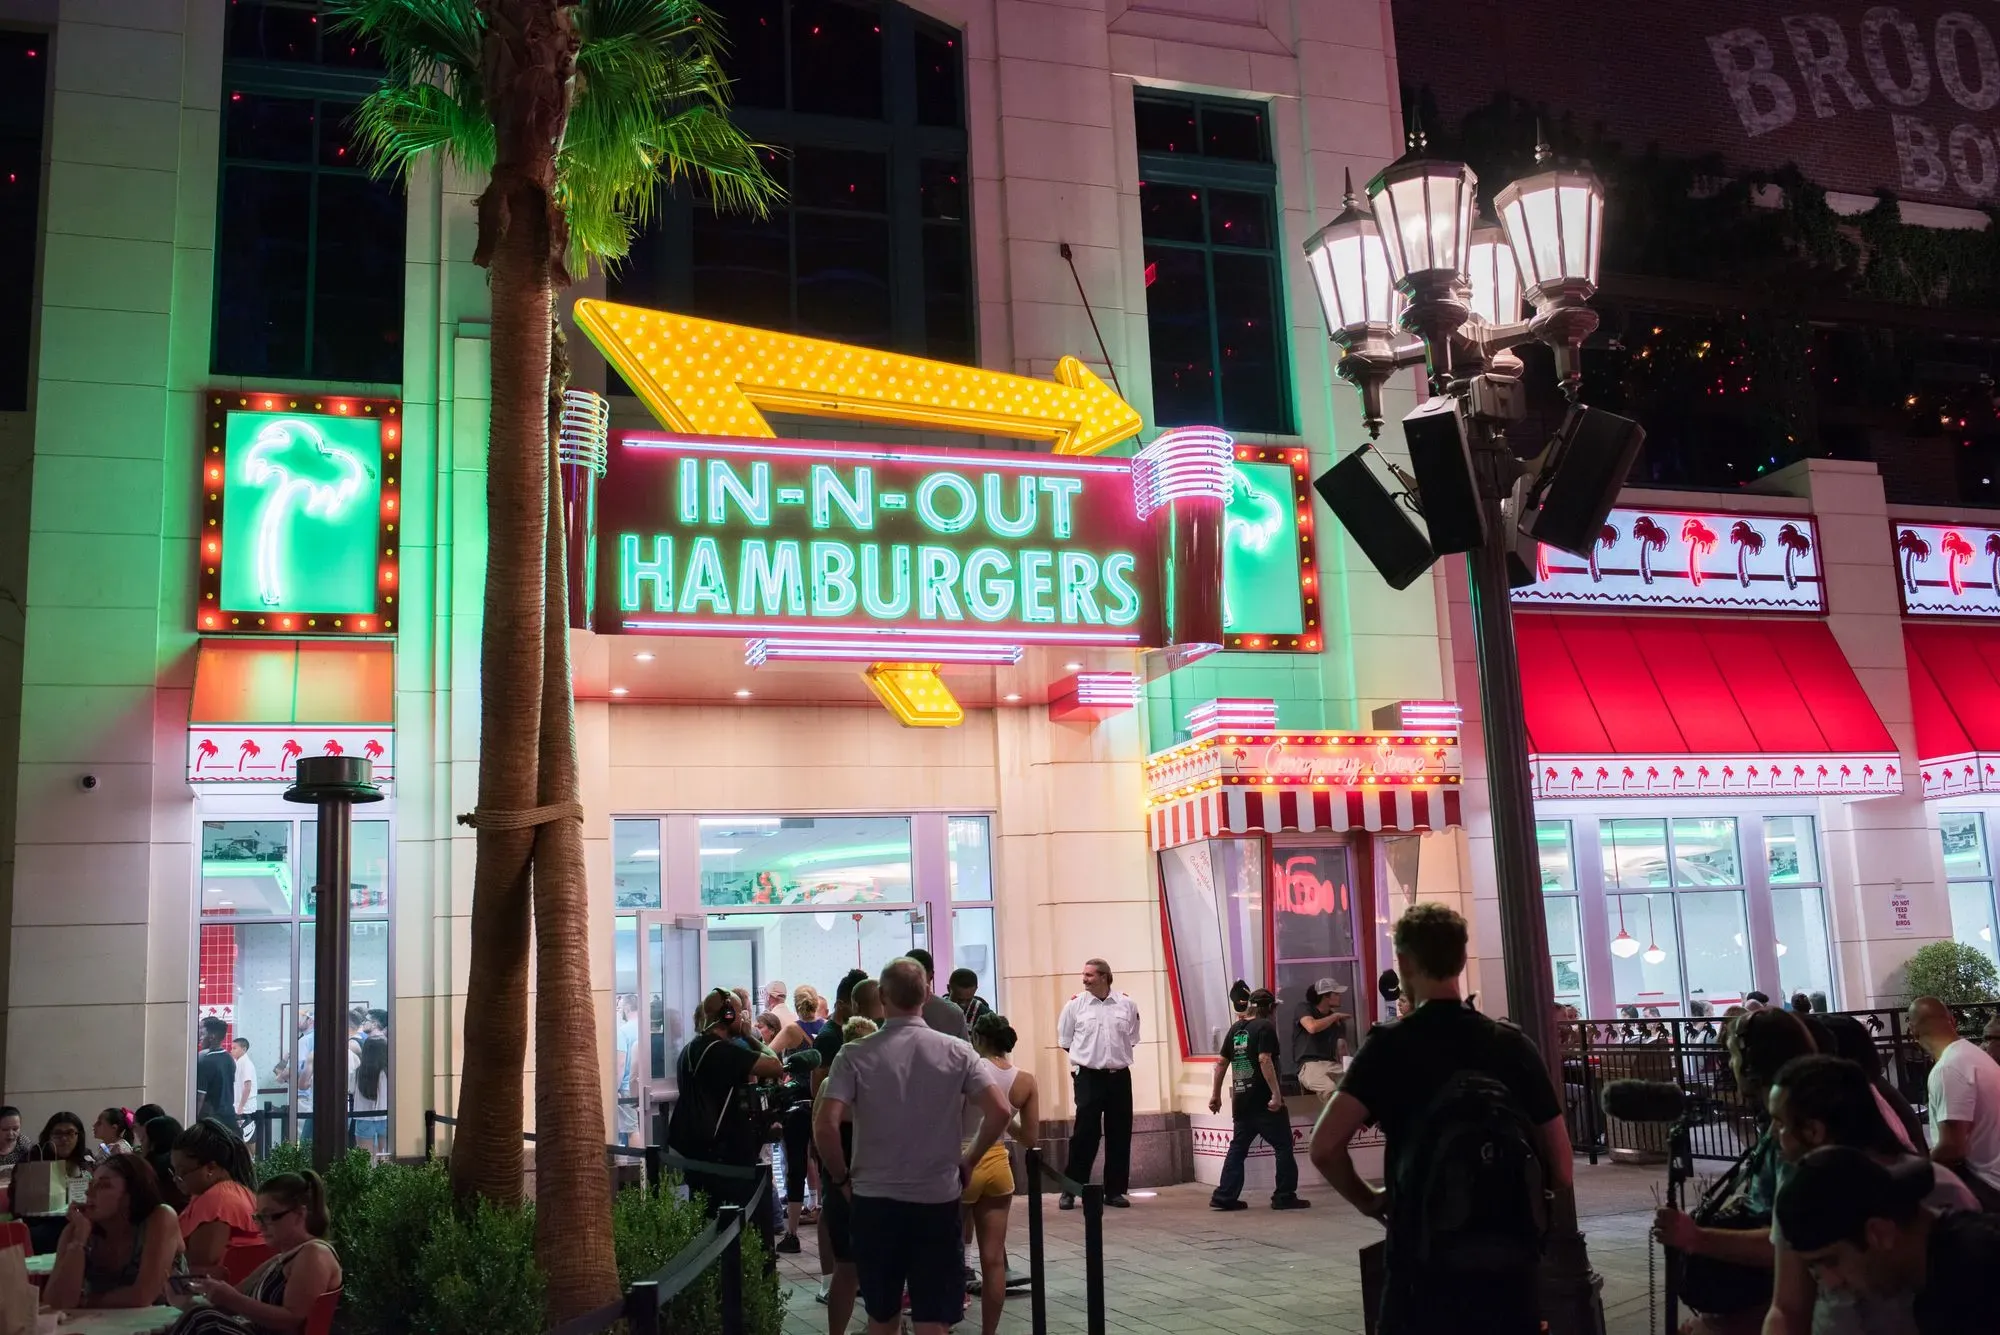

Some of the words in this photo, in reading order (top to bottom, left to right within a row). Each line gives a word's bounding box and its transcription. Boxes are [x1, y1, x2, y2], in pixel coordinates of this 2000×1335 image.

[1892, 113, 2000, 198] BO
[679, 456, 1083, 539] IN-N-OUT
[619, 534, 1139, 626] HAMBURGERS
[1265, 741, 1365, 786] Company
[1373, 743, 1425, 775] Store
